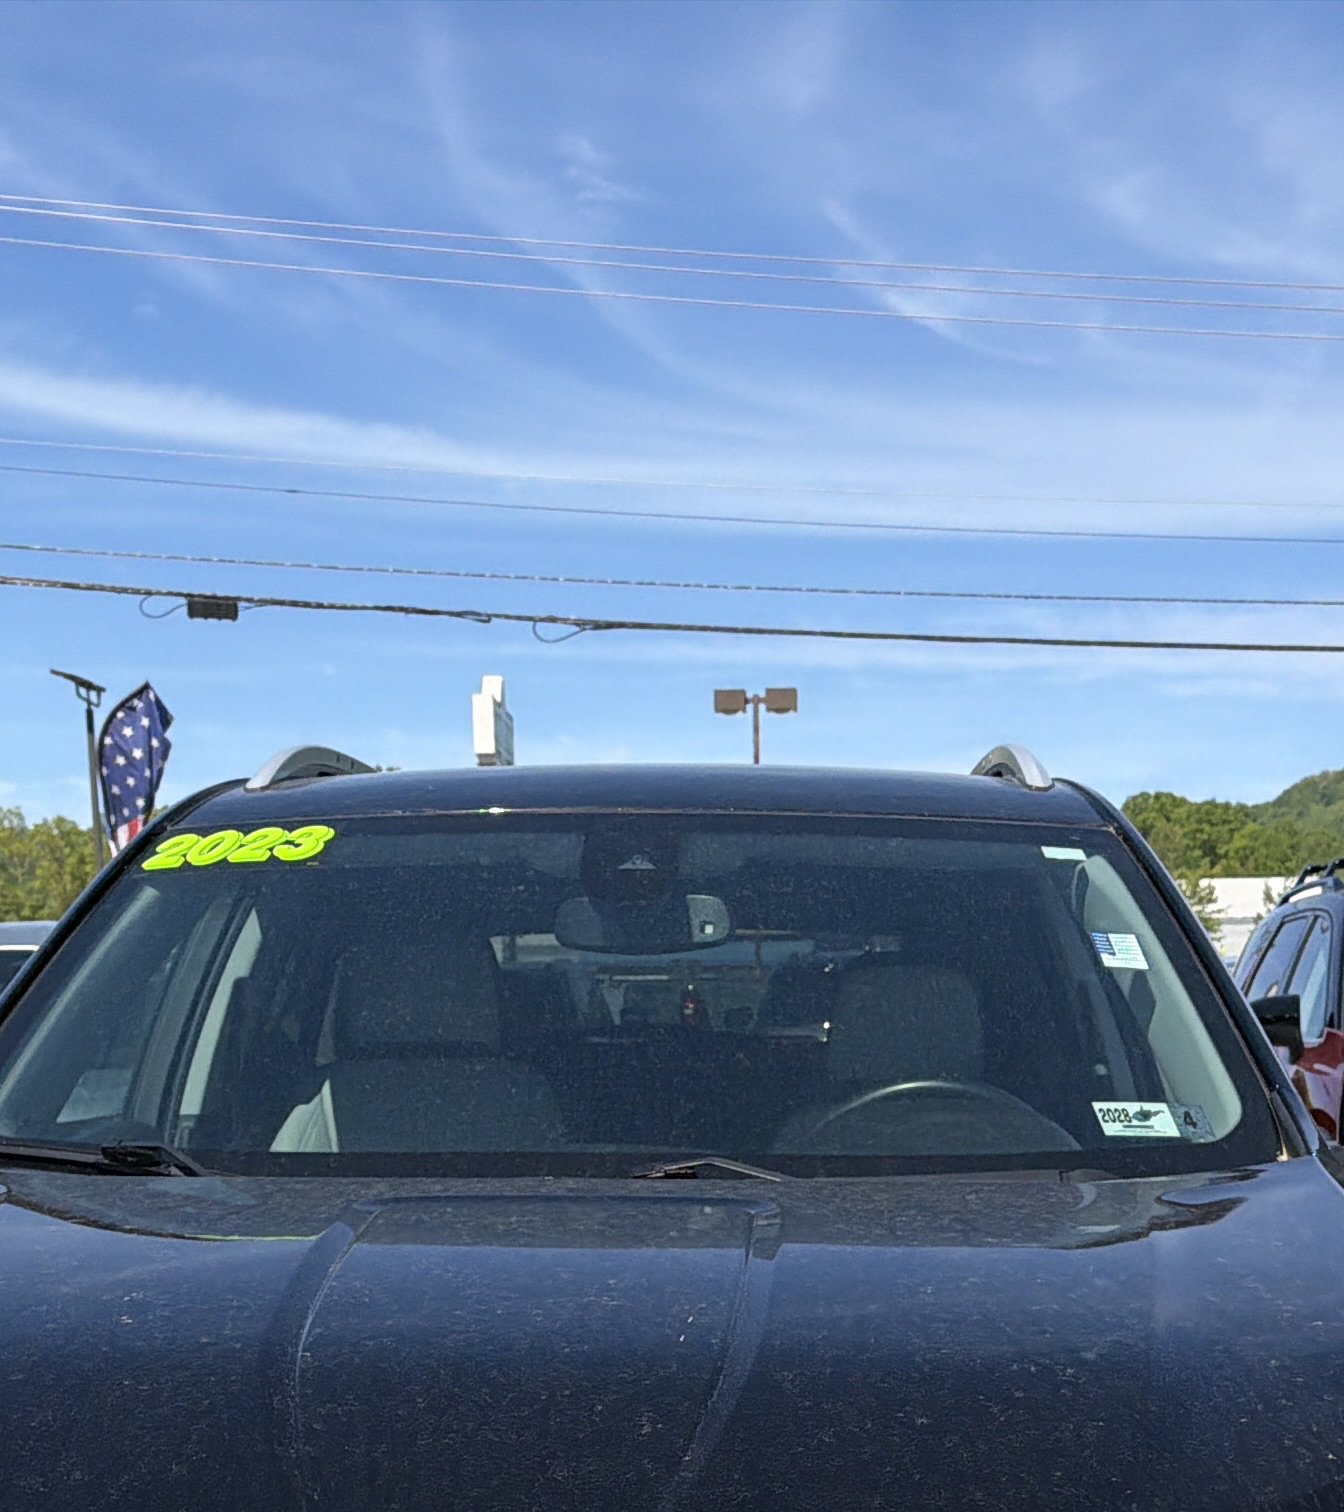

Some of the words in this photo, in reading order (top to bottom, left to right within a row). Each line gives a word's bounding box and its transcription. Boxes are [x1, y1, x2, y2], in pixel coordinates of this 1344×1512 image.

[141, 825, 335, 871] 2023
[1098, 1107, 1133, 1123] 2028
[1183, 1110, 1198, 1130] 4
